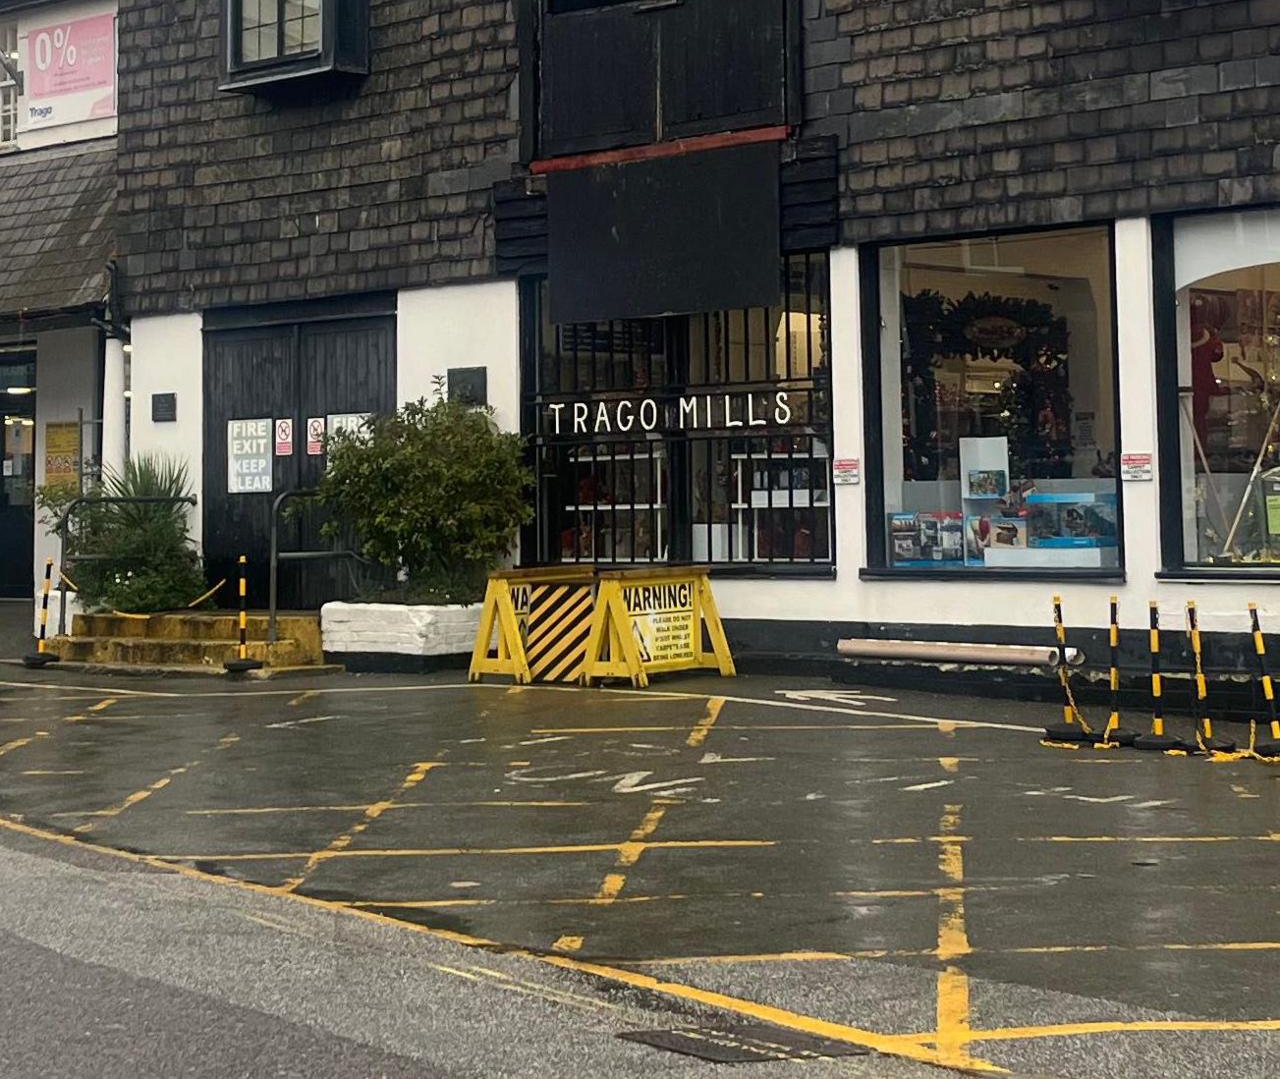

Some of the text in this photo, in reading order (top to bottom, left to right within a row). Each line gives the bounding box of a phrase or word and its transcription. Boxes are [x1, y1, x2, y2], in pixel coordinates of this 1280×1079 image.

[35, 25, 76, 71] 0%
[29, 106, 53, 118] Trago
[549, 391, 792, 435] TRAGO MILLS
[233, 422, 267, 438] FIRE
[232, 439, 267, 455] EXIT
[234, 459, 266, 473] KEEP
[623, 583, 692, 612] WARNING!
